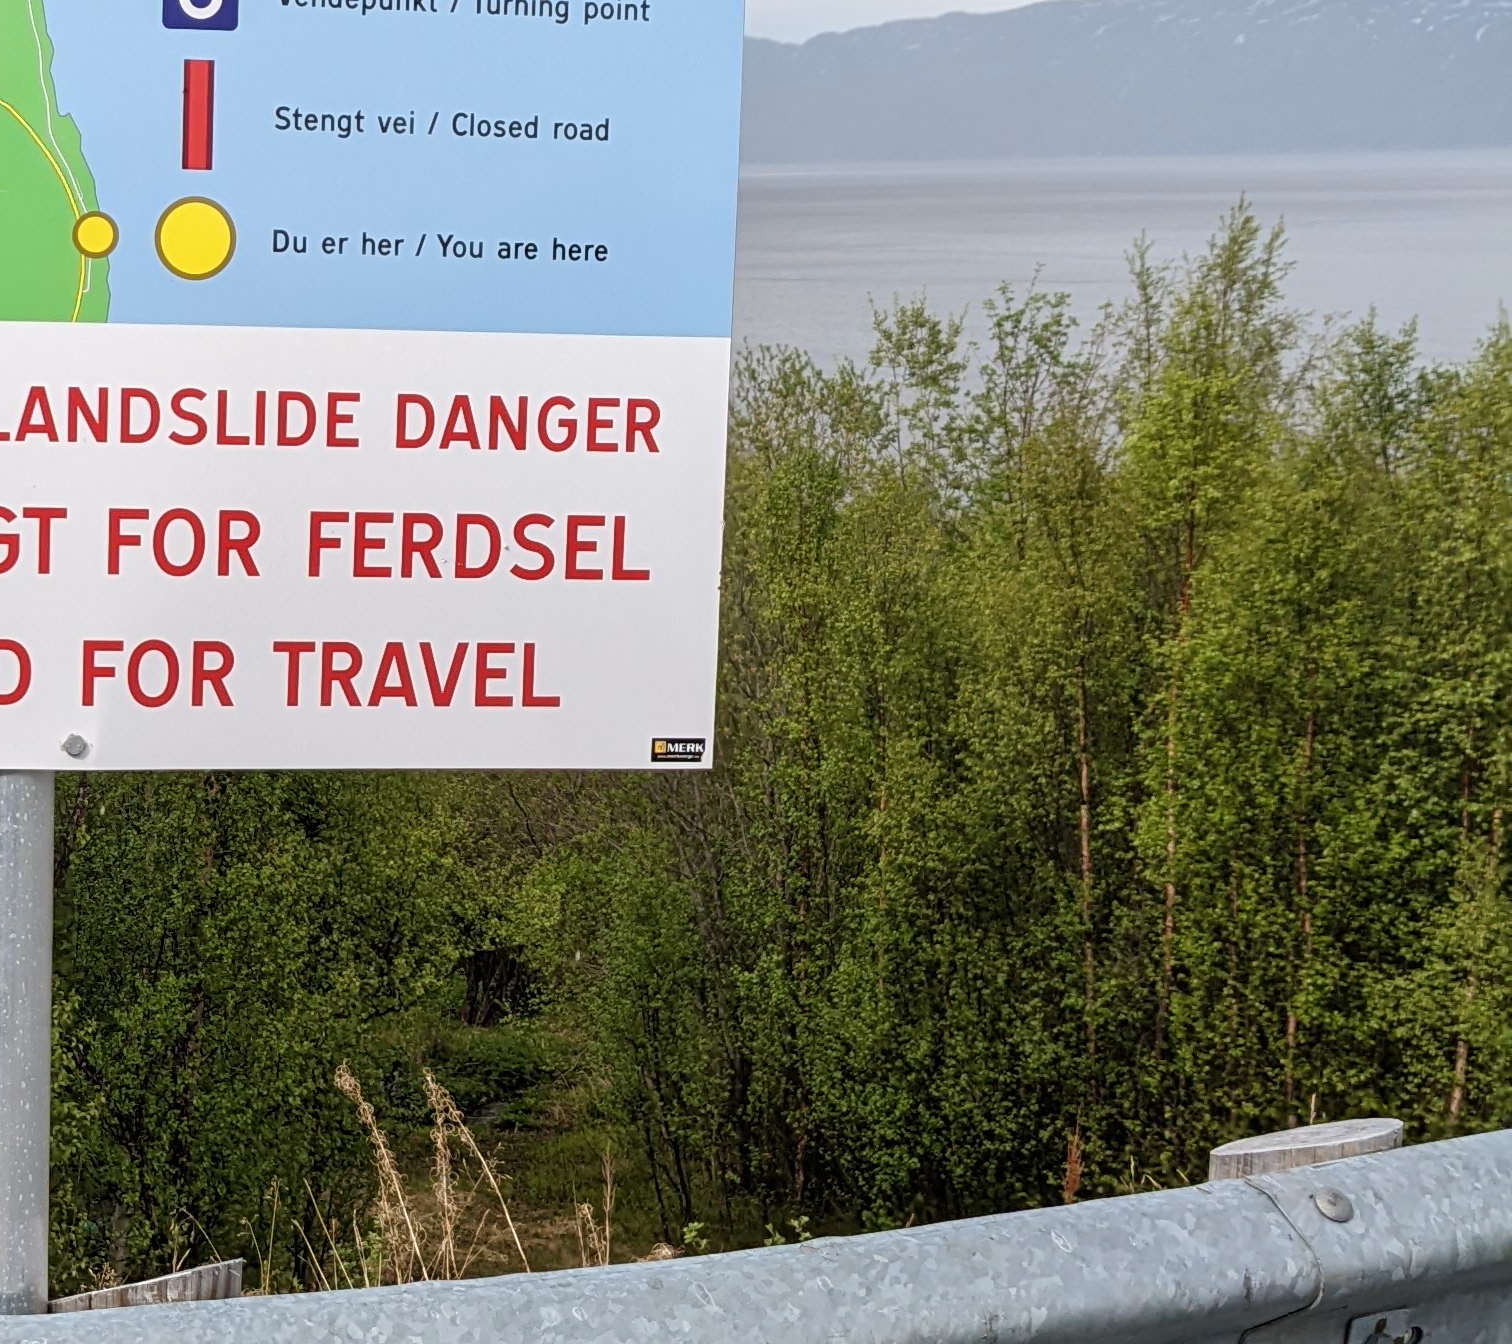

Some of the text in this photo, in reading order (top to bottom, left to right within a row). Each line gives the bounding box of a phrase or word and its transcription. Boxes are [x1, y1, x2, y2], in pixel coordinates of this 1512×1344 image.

[275, 106, 609, 141] Stengt vei / Closed road
[272, 229, 608, 262] Du er her / You are here
[395, 393, 661, 454] DANGER
[106, 507, 261, 578] FOR
[307, 511, 650, 582] FERDSEL
[81, 639, 234, 709] FOR
[272, 641, 561, 708] TRAVEL
[667, 743, 704, 753] MERK
